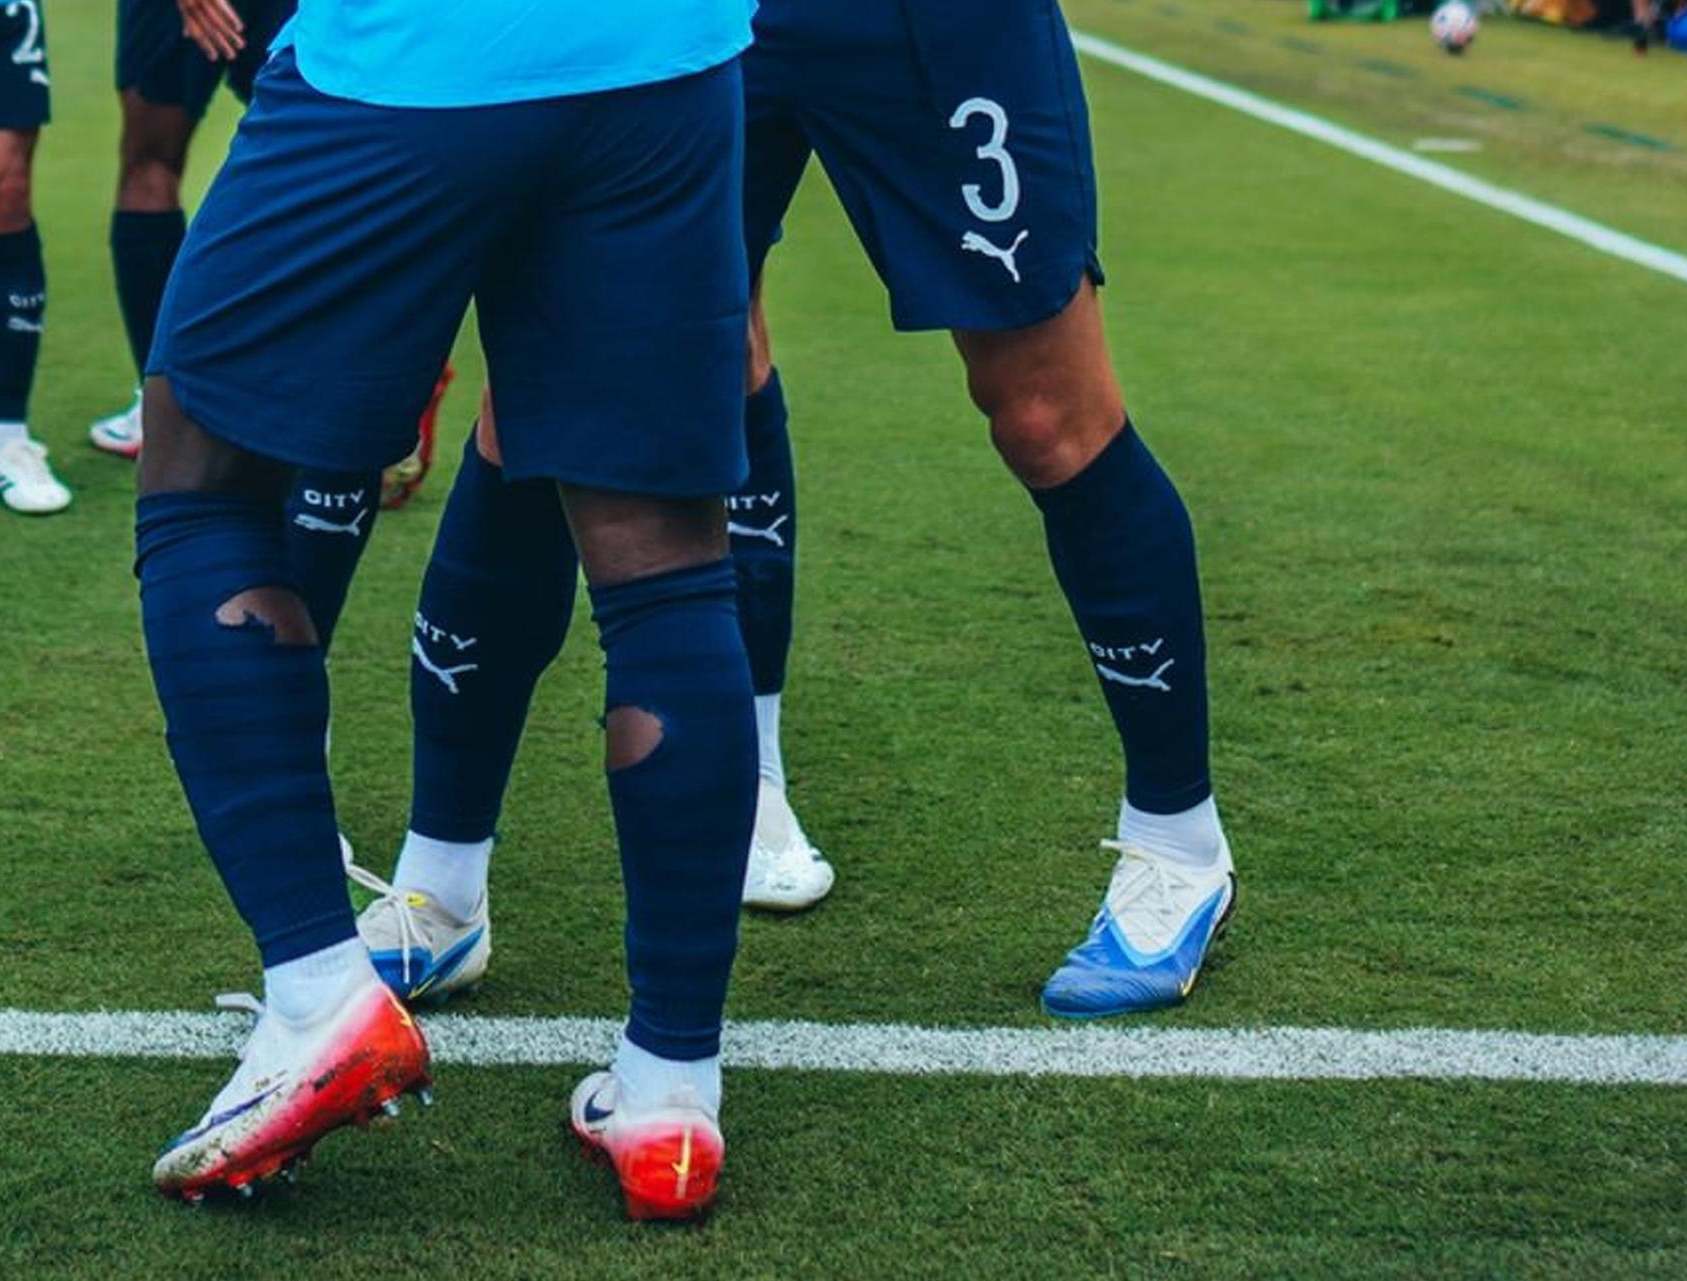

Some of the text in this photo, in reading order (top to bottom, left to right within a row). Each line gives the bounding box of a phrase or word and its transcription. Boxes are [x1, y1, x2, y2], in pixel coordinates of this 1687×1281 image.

[949, 97, 1020, 222] 3
[303, 488, 365, 508] CITY
[724, 490, 781, 511] ITY
